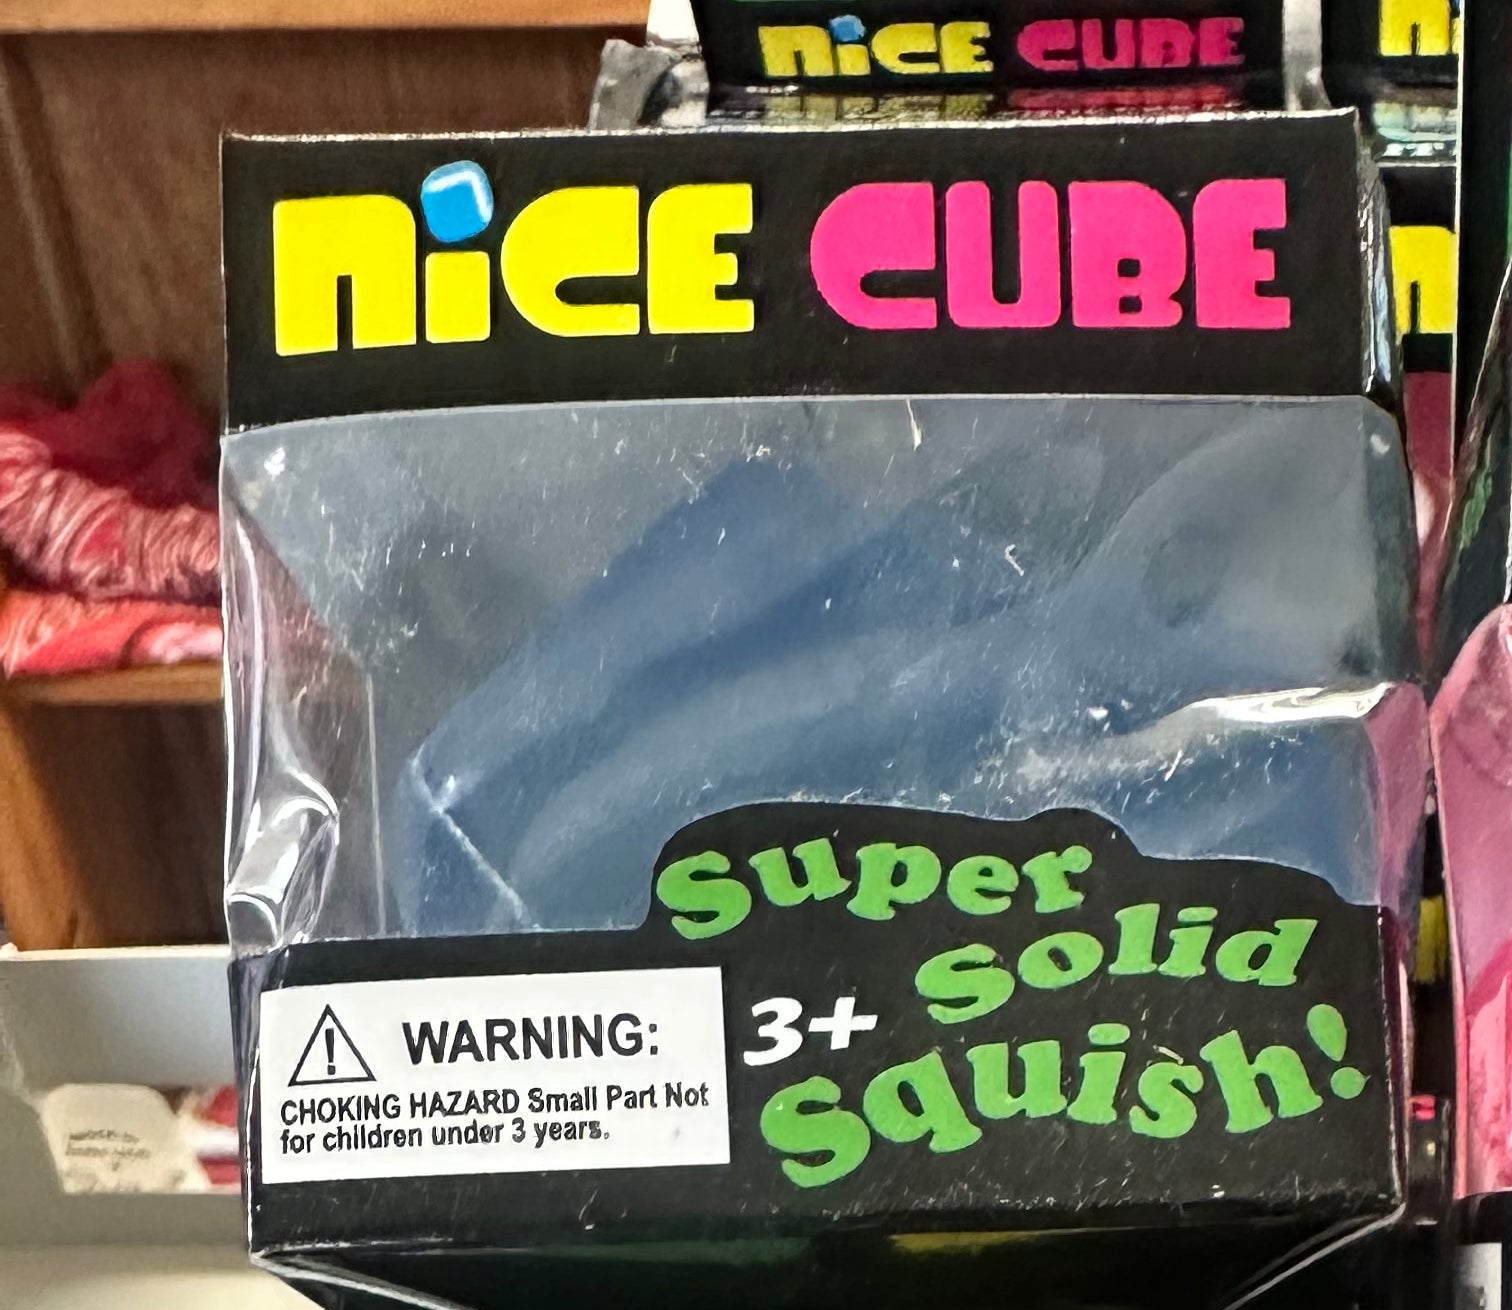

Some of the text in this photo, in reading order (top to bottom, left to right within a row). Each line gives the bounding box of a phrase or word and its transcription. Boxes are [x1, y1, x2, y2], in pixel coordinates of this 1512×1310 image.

[1016, 17, 1245, 71] CUBE
[809, 177, 1292, 330] CUBE
[655, 837, 1093, 941] Super
[402, 1012, 660, 1065] WARNING:
[744, 997, 878, 1067] 3+
[280, 1081, 709, 1126] CHOKING HAZARD Small Part Not
[759, 1003, 1367, 1188] Squish!
[280, 1117, 610, 1155] for children under 3 years.
